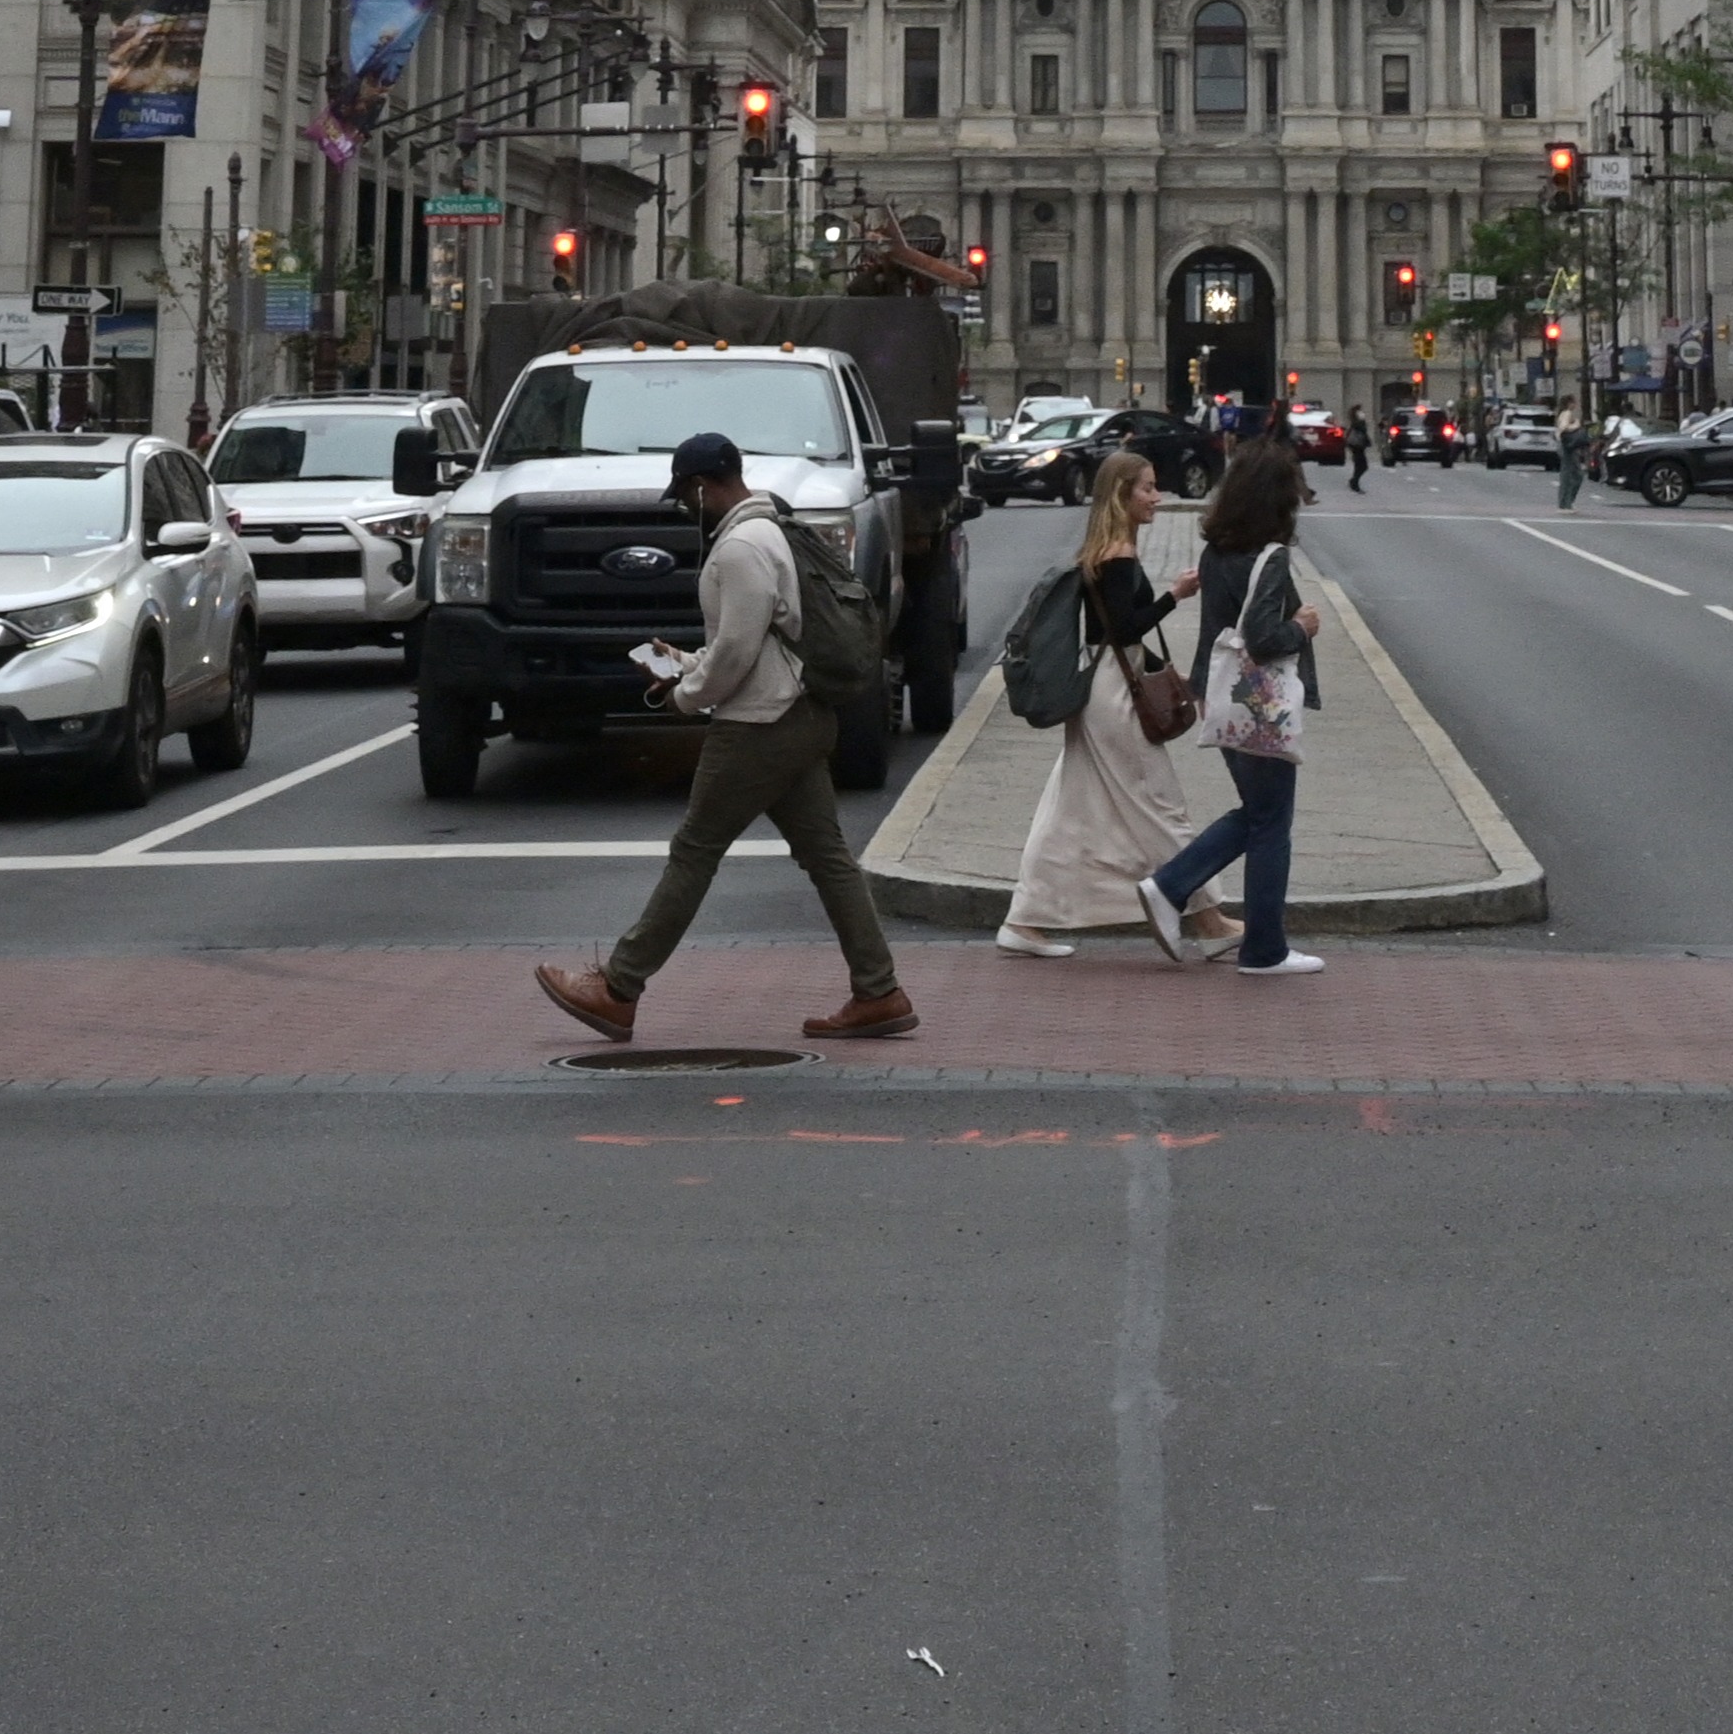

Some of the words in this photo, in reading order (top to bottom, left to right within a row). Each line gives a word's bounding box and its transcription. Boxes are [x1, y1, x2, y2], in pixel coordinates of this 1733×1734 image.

[1601, 162, 1620, 175] NO
[41, 293, 63, 305] ONE
[67, 293, 91, 305] WAY
